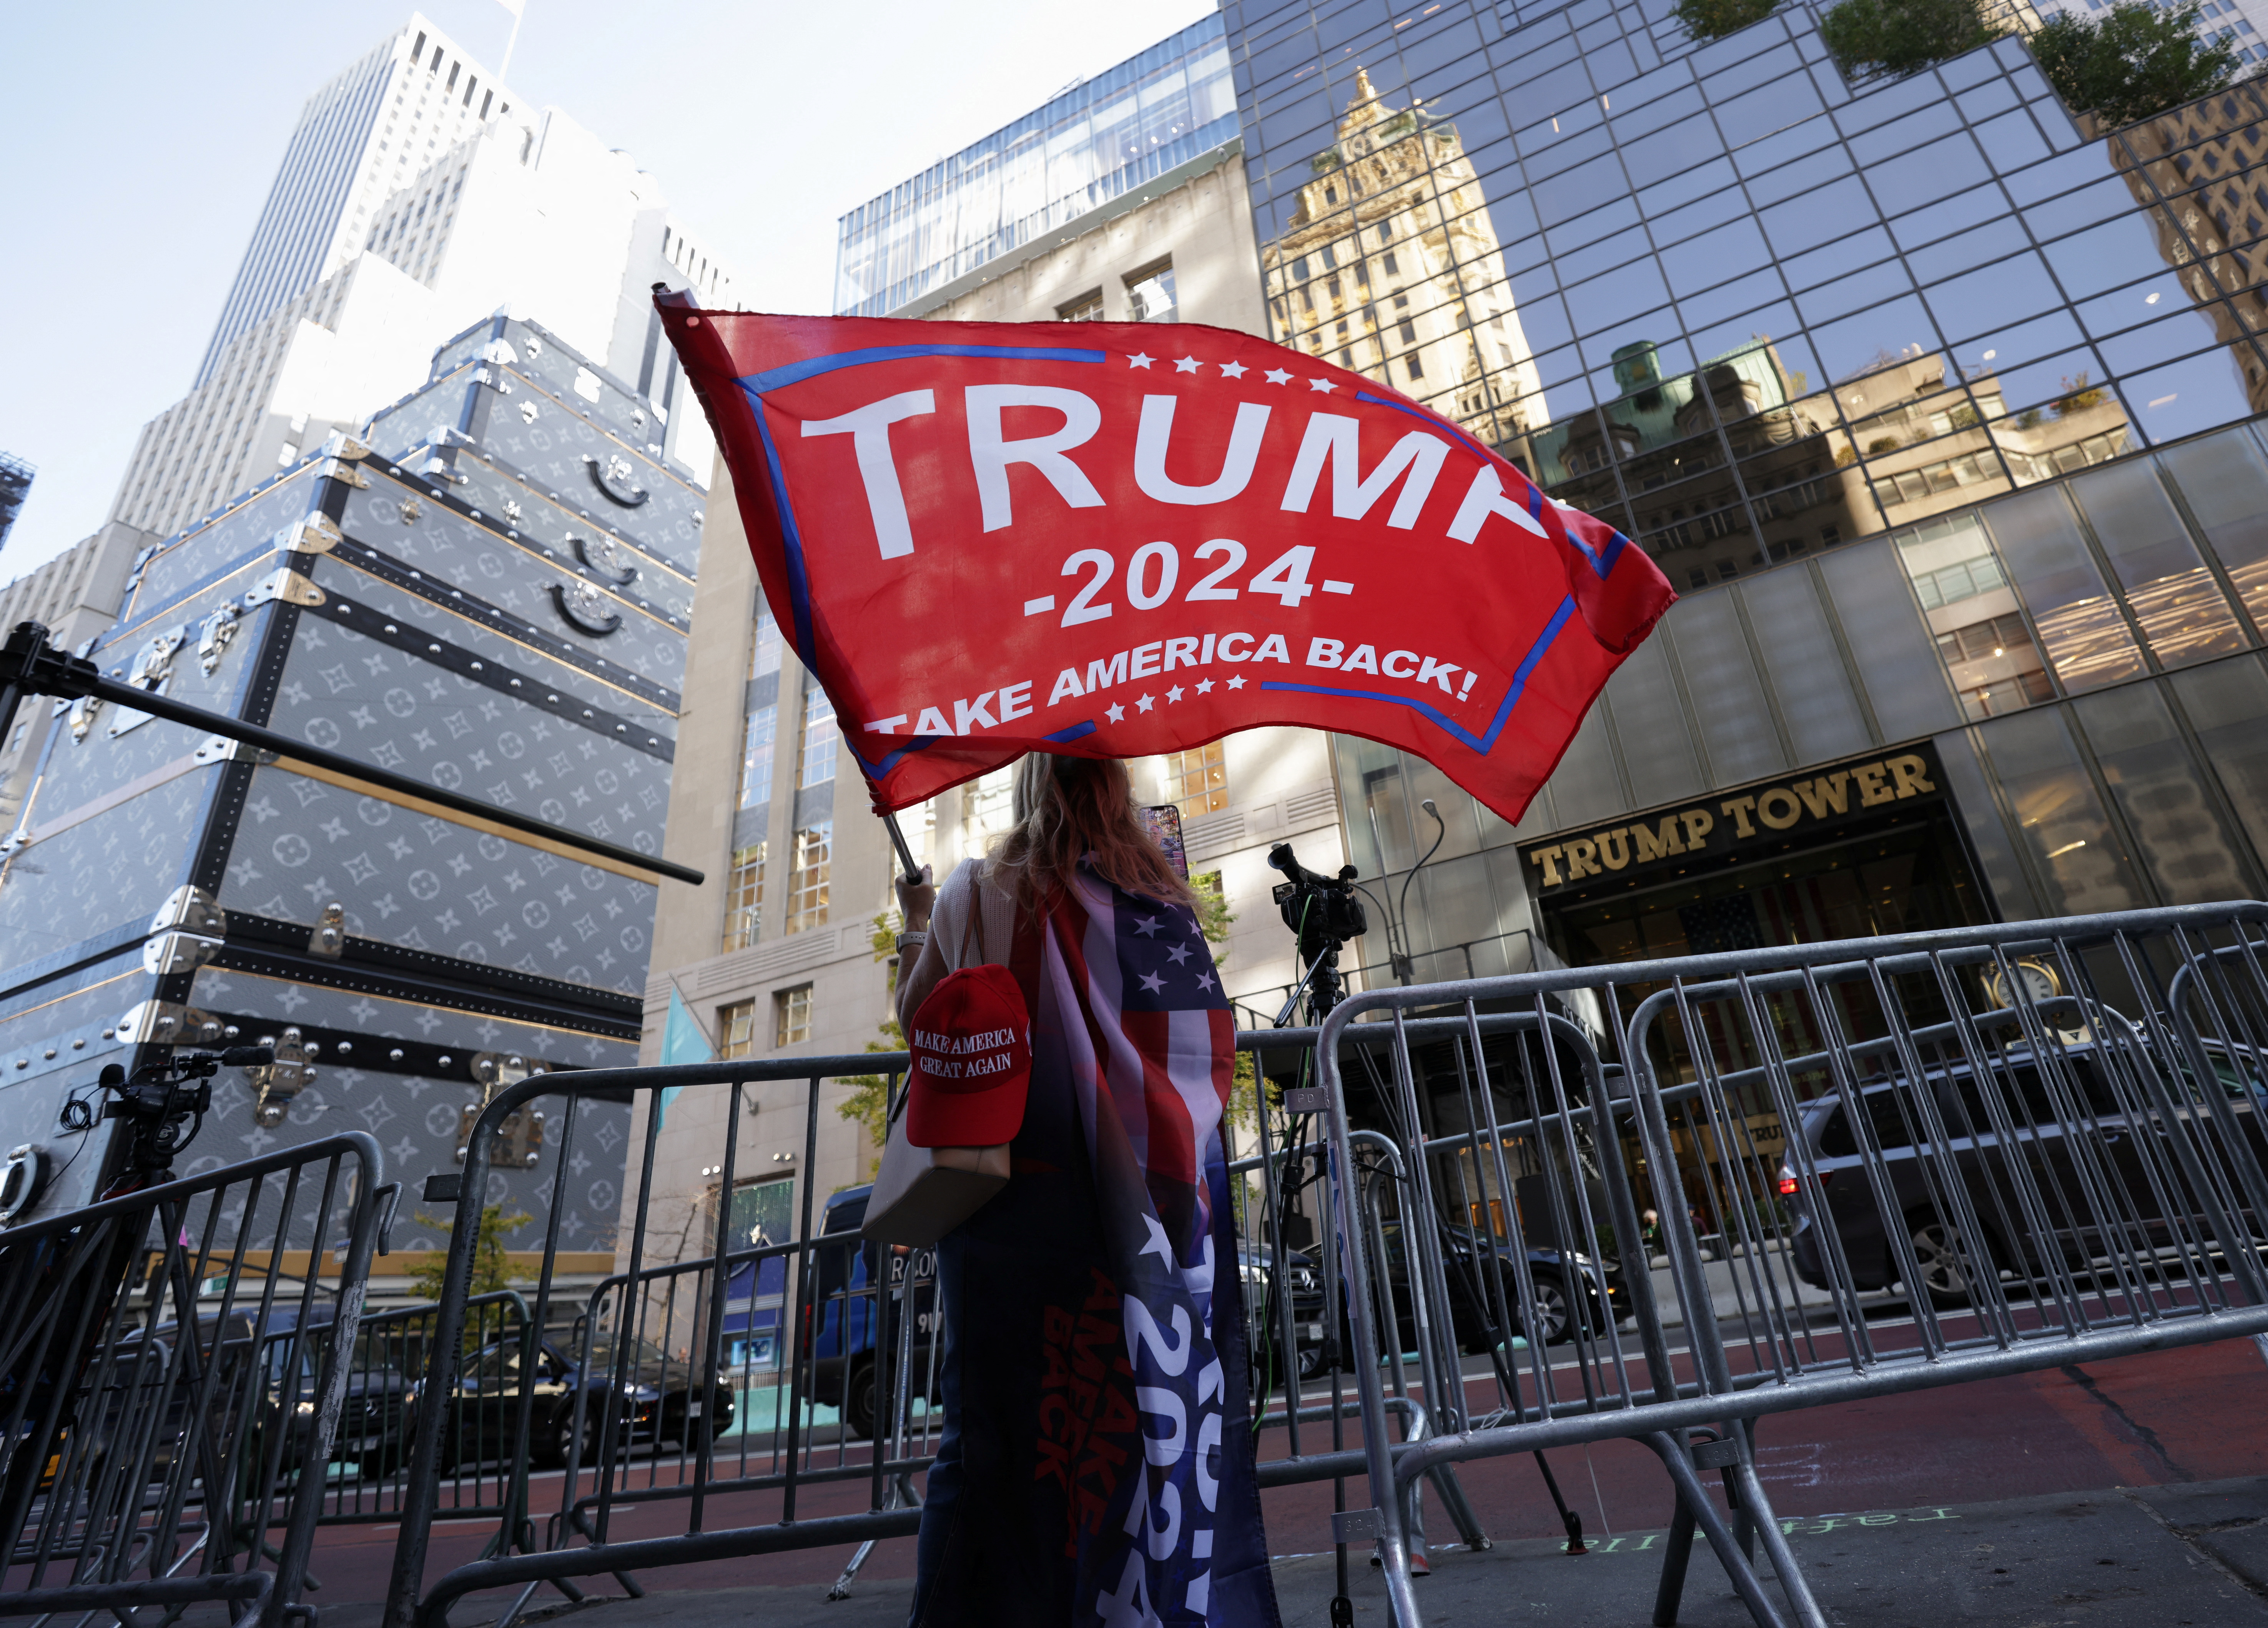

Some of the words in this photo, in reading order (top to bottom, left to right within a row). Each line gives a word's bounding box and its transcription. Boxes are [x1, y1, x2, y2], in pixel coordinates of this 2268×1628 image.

[1024, 539, 1354, 628] -2024-
[1046, 631, 1291, 707] AMERICA
[1305, 636, 1478, 703] BACK!
[1531, 808, 1714, 887] TRUMP
[1721, 754, 1936, 839] TOWER
[915, 1029, 950, 1054] MAKE
[950, 1027, 1016, 1054] AMERICA
[920, 1056, 961, 1078] GREAT
[965, 1052, 1011, 1078] AGAIN
[1034, 1305, 1075, 1493] BACK
